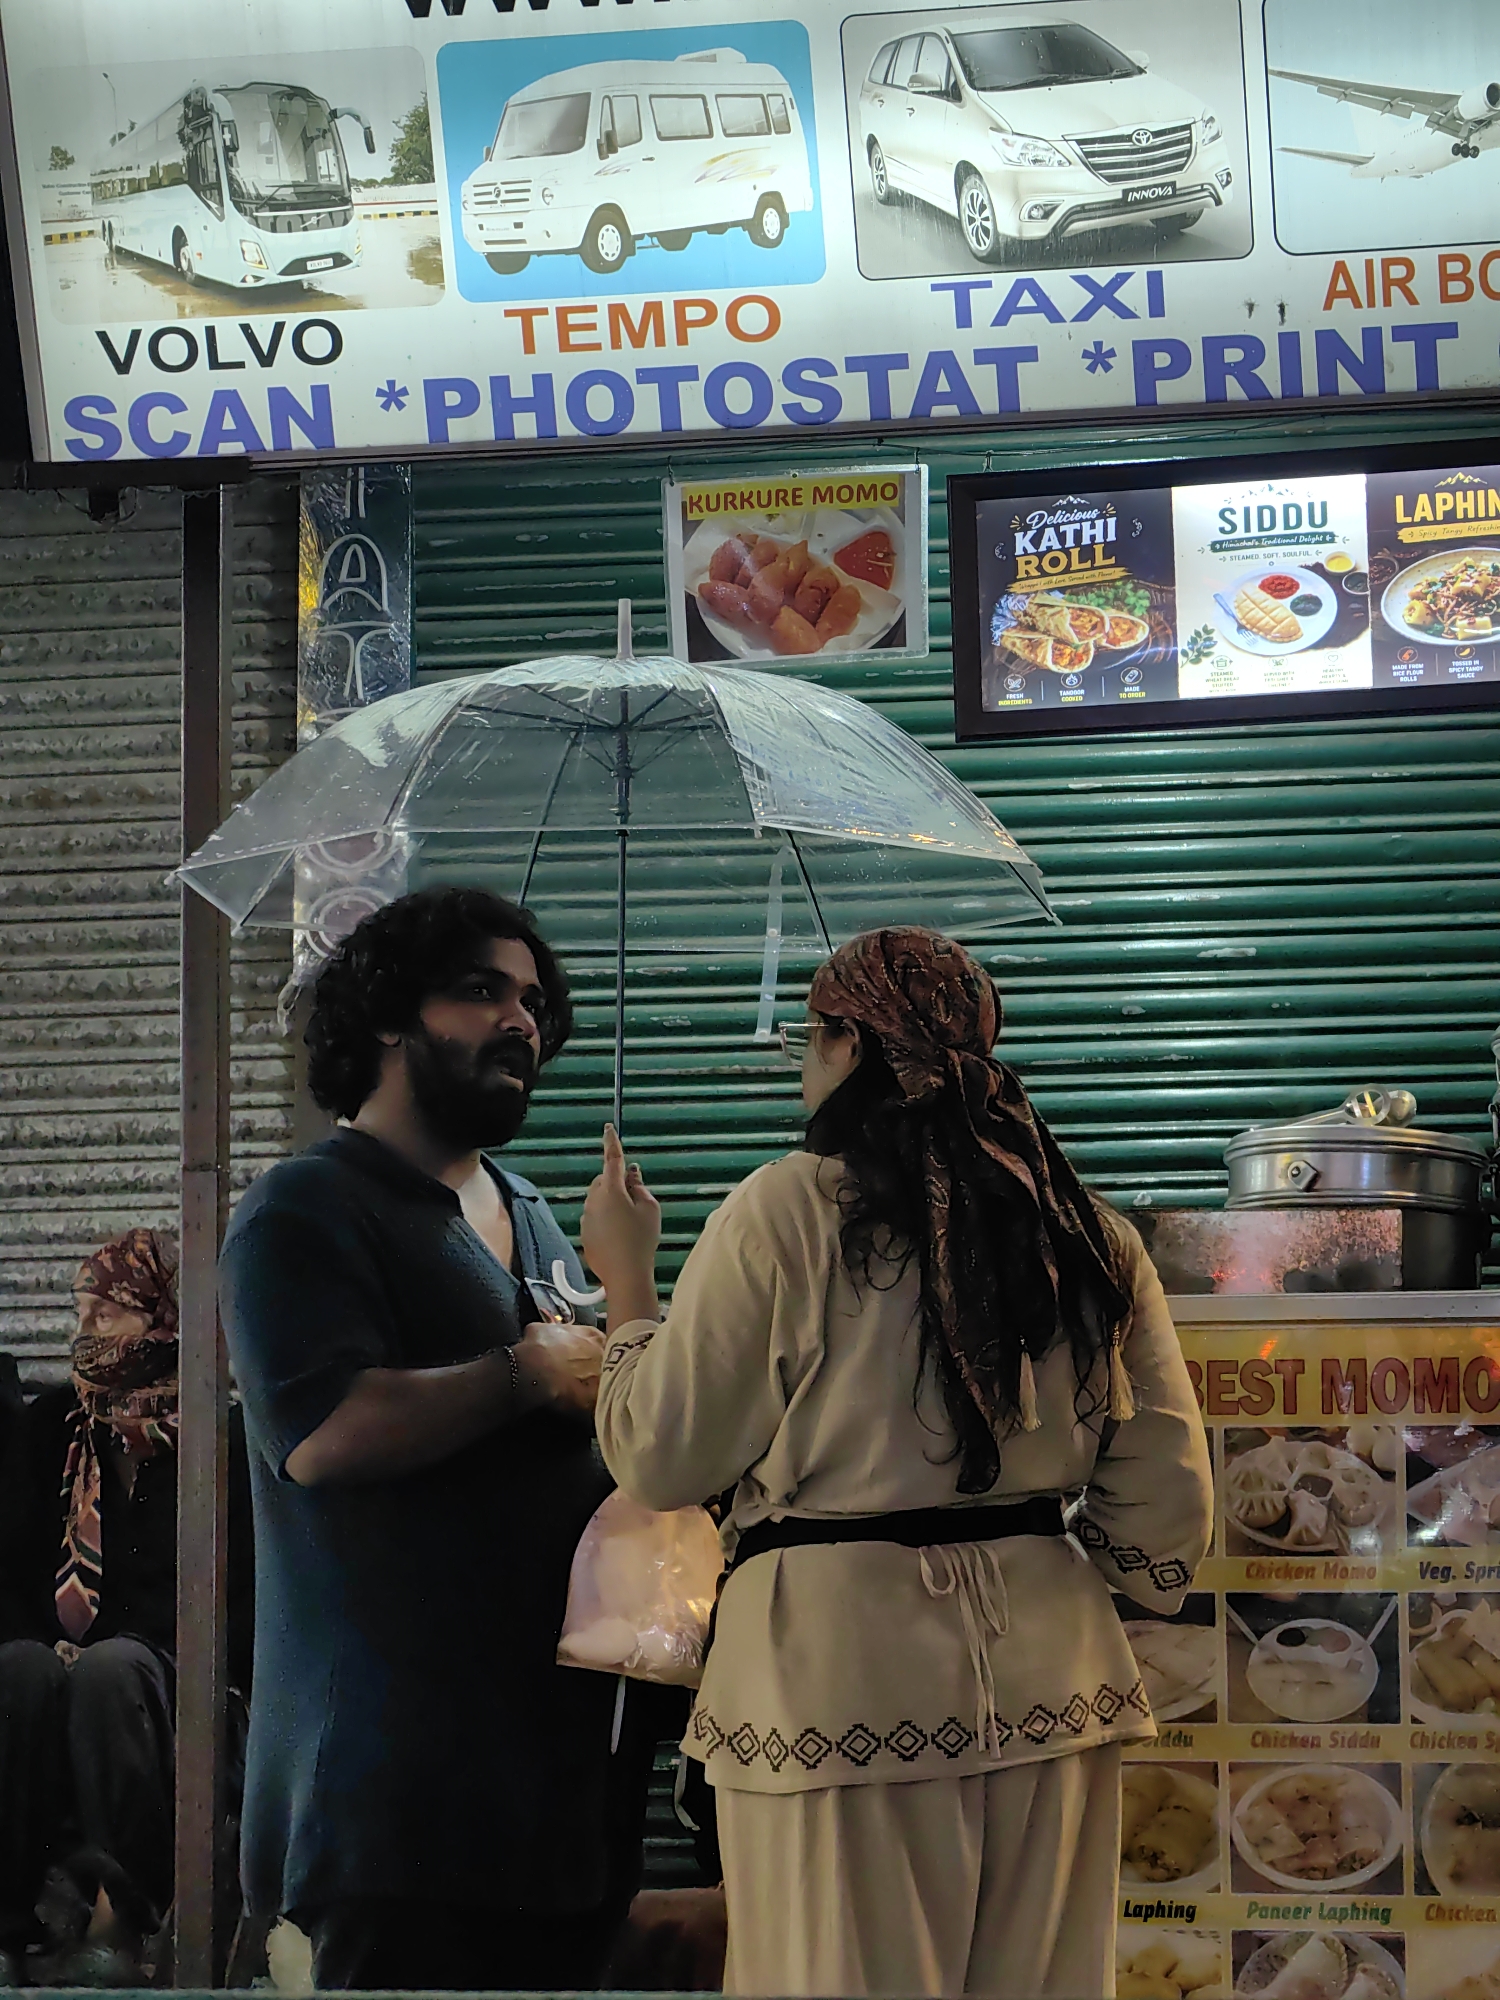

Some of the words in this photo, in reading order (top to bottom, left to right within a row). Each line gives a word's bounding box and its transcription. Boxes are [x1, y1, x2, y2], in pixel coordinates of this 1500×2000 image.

[1127, 185, 1174, 203] INNOVA
[1322, 256, 1420, 311] AIR
[930, 270, 1165, 329] TAXI
[505, 296, 781, 355] TEMPO
[96, 319, 342, 374] VOLVO
[64, 385, 335, 461] SCAN
[688, 487, 803, 514] KURKURE
[812, 482, 899, 505] MOMO
[1026, 508, 1101, 529] Delicious
[1218, 500, 1328, 535] SIDDU
[1014, 517, 1117, 556] KATHI
[1260, 535, 1298, 546] Traditional
[1299, 534, 1324, 544] Delight
[1418, 529, 1438, 538] Spicy
[1442, 527, 1463, 535] Tangy
[1015, 543, 1116, 580] ROLL
[1229, 553, 1261, 561] STEAMED.
[1282, 550, 1312, 558] SOULFUL.
[1465, 665, 1484, 673] TANGY
[1059, 689, 1085, 697] TANDOOR
[1321, 1356, 1500, 1414] MOMO
[1245, 1561, 1316, 1580] Chicken
[1323, 1561, 1377, 1580] Momo
[1419, 1561, 1457, 1584] Veg.
[1250, 1730, 1322, 1749] Chicken
[1328, 1730, 1382, 1749] Siddu
[1409, 1730, 1478, 1750] Chicken
[1123, 1900, 1198, 1924] Laphing
[1318, 1902, 1393, 1926] Laphing
[1425, 1903, 1498, 1923] Chicken
